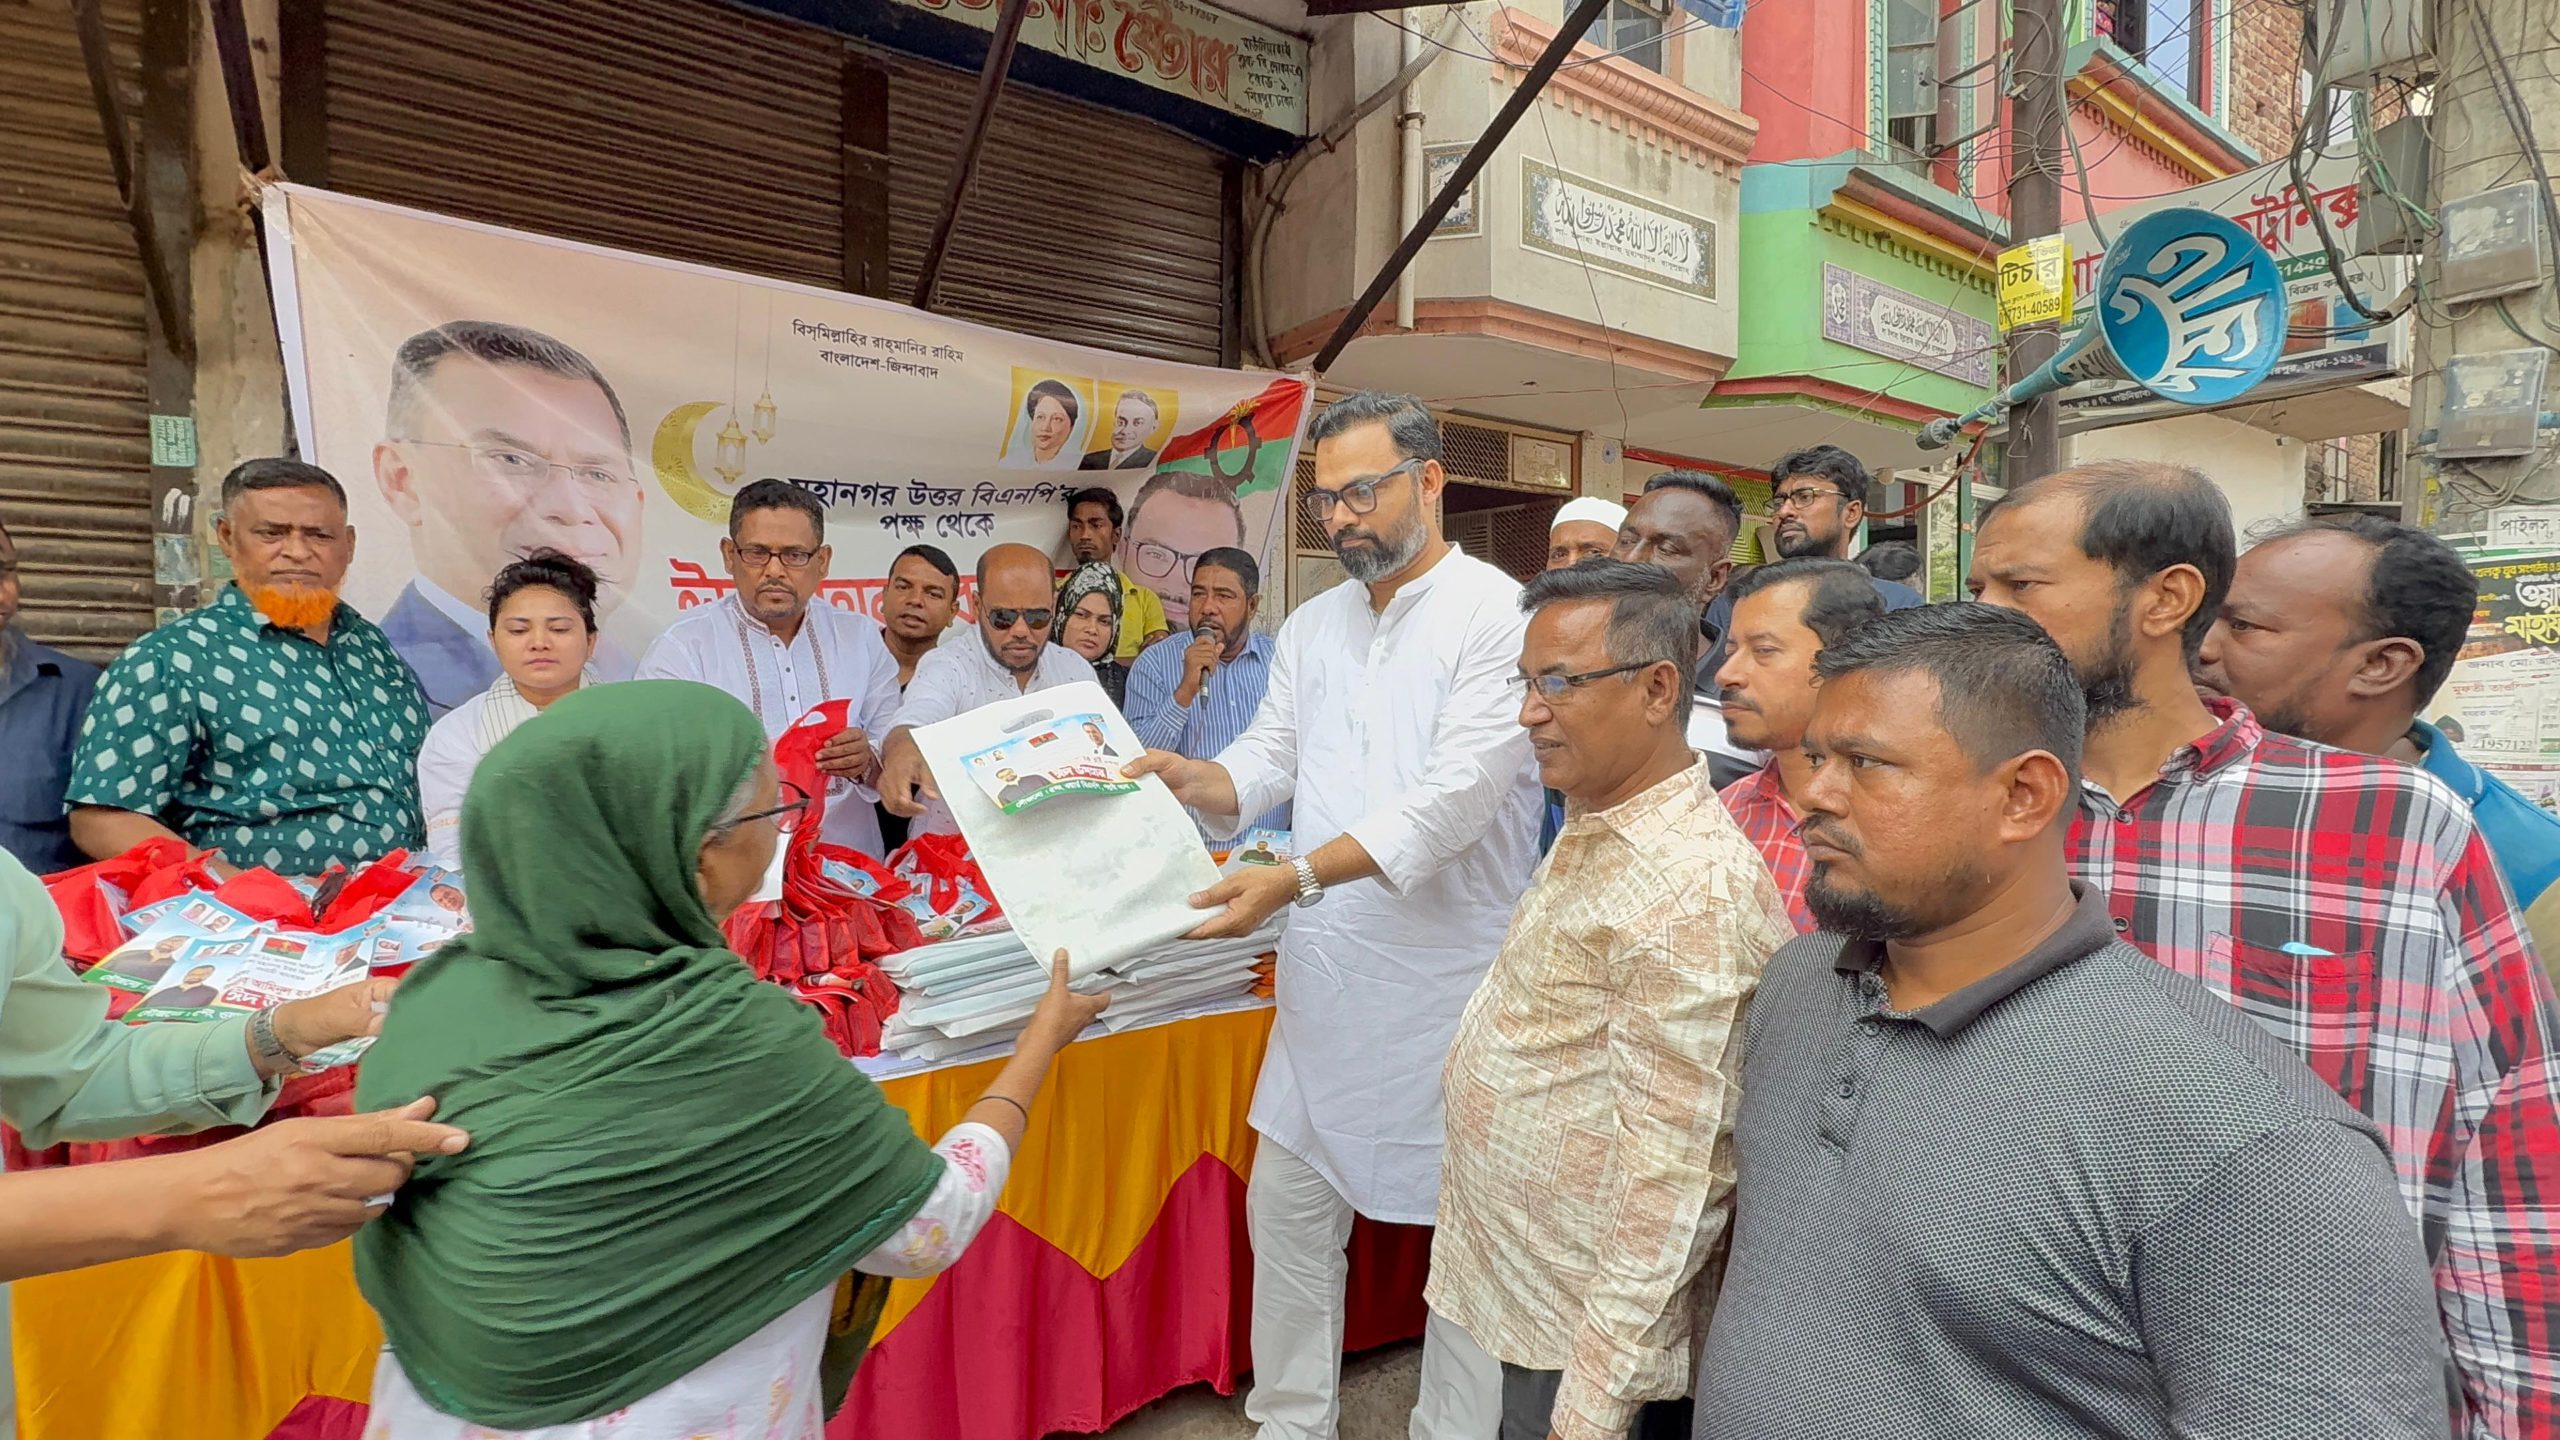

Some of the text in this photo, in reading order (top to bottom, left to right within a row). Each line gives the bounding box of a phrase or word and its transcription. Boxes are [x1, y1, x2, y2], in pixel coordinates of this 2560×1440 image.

[1998, 256, 2061, 291] টিচার
[819, 348, 940, 380] বাংলাদেশ-জিন্দাবাদ
[931, 343, 965, 364] রাহিম
[906, 478, 966, 508] উত্তর
[879, 510, 998, 541] পক্ষ থেকে
